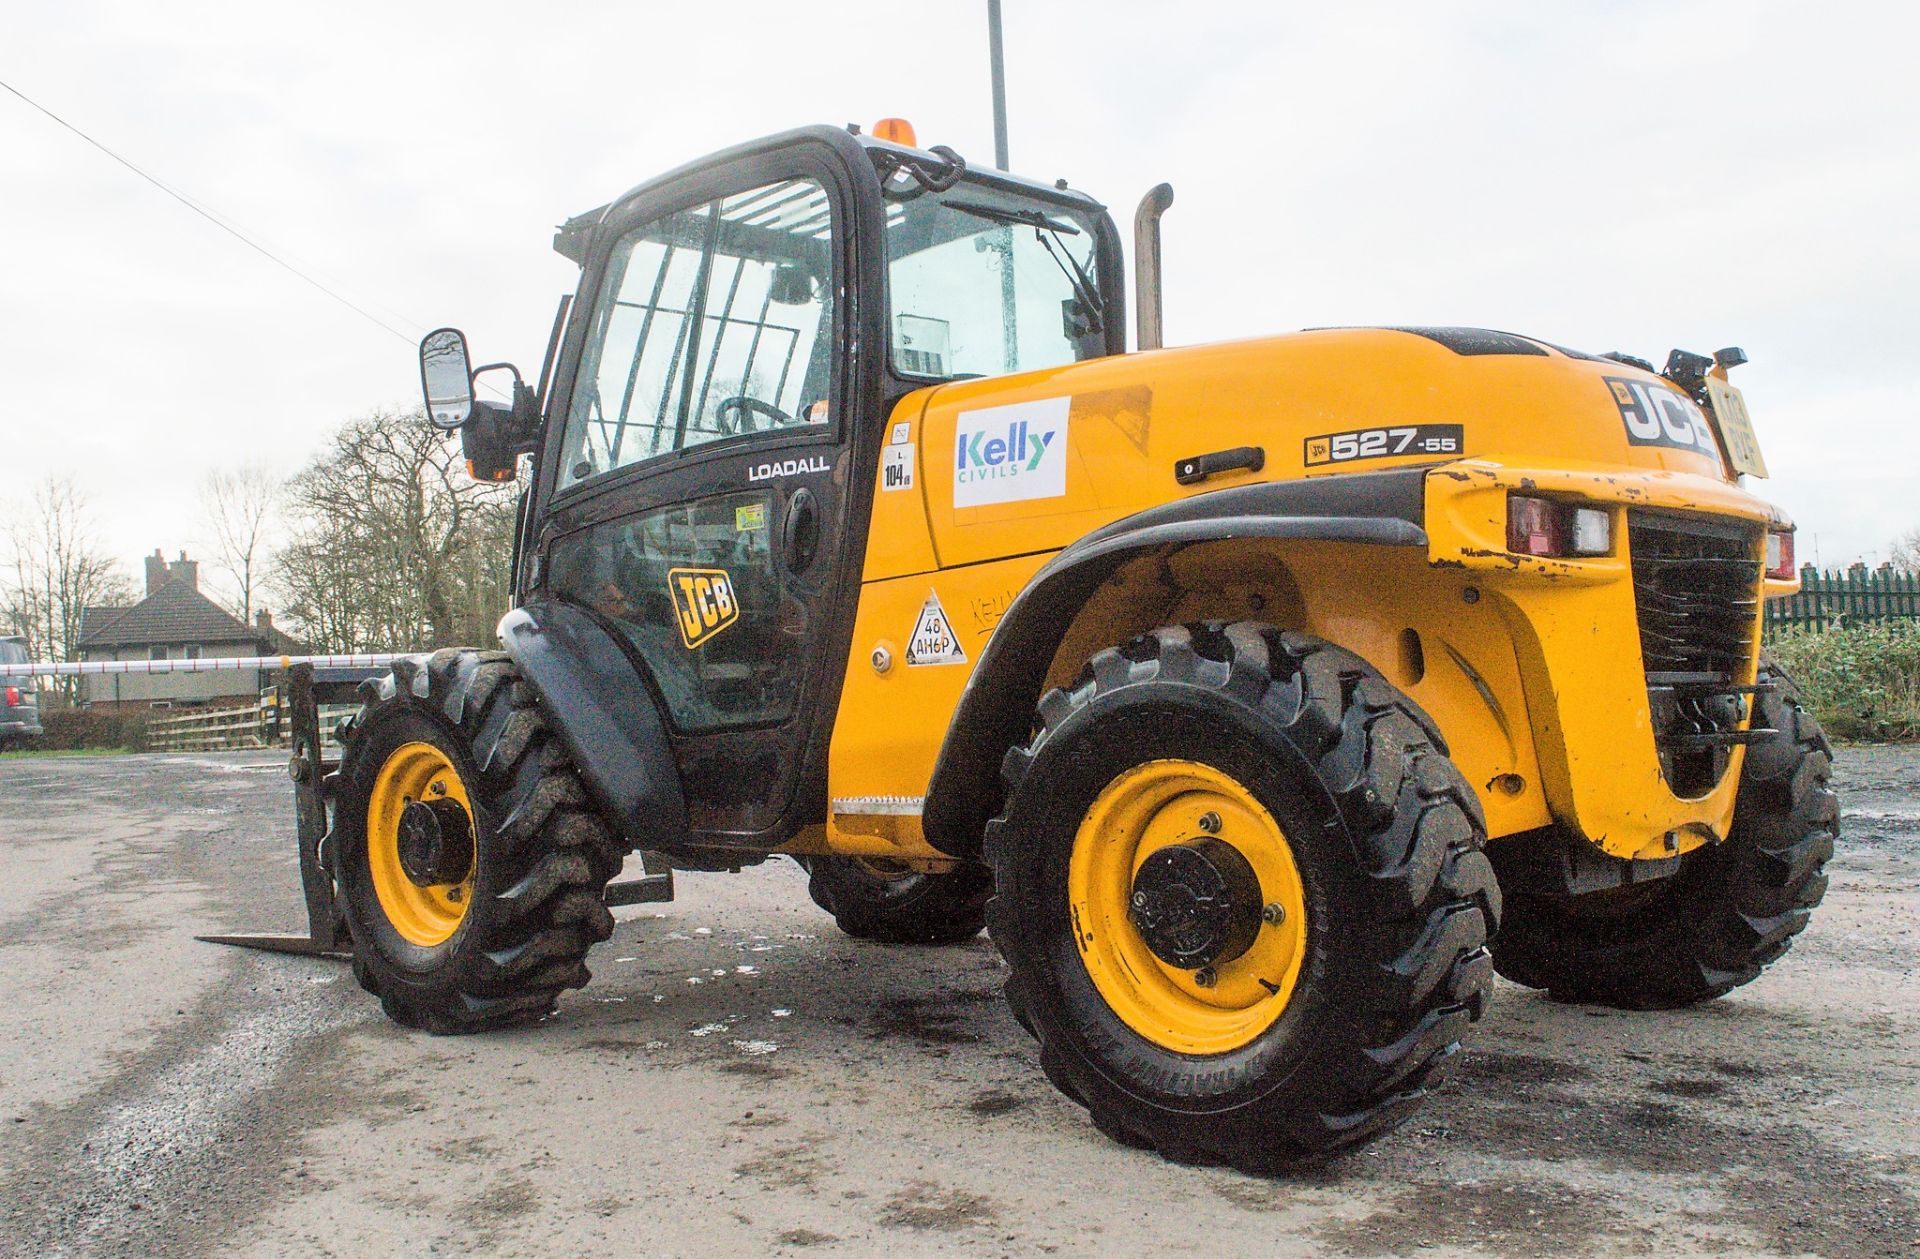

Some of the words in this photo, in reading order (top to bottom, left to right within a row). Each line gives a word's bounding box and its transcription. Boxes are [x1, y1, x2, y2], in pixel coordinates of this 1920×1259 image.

[957, 420, 1056, 472] Kelly
[748, 456, 831, 482] LOADALL
[885, 463, 904, 487] 104
[958, 464, 1019, 484] CIVILS
[678, 576, 733, 639] JCB
[924, 617, 942, 635] 48
